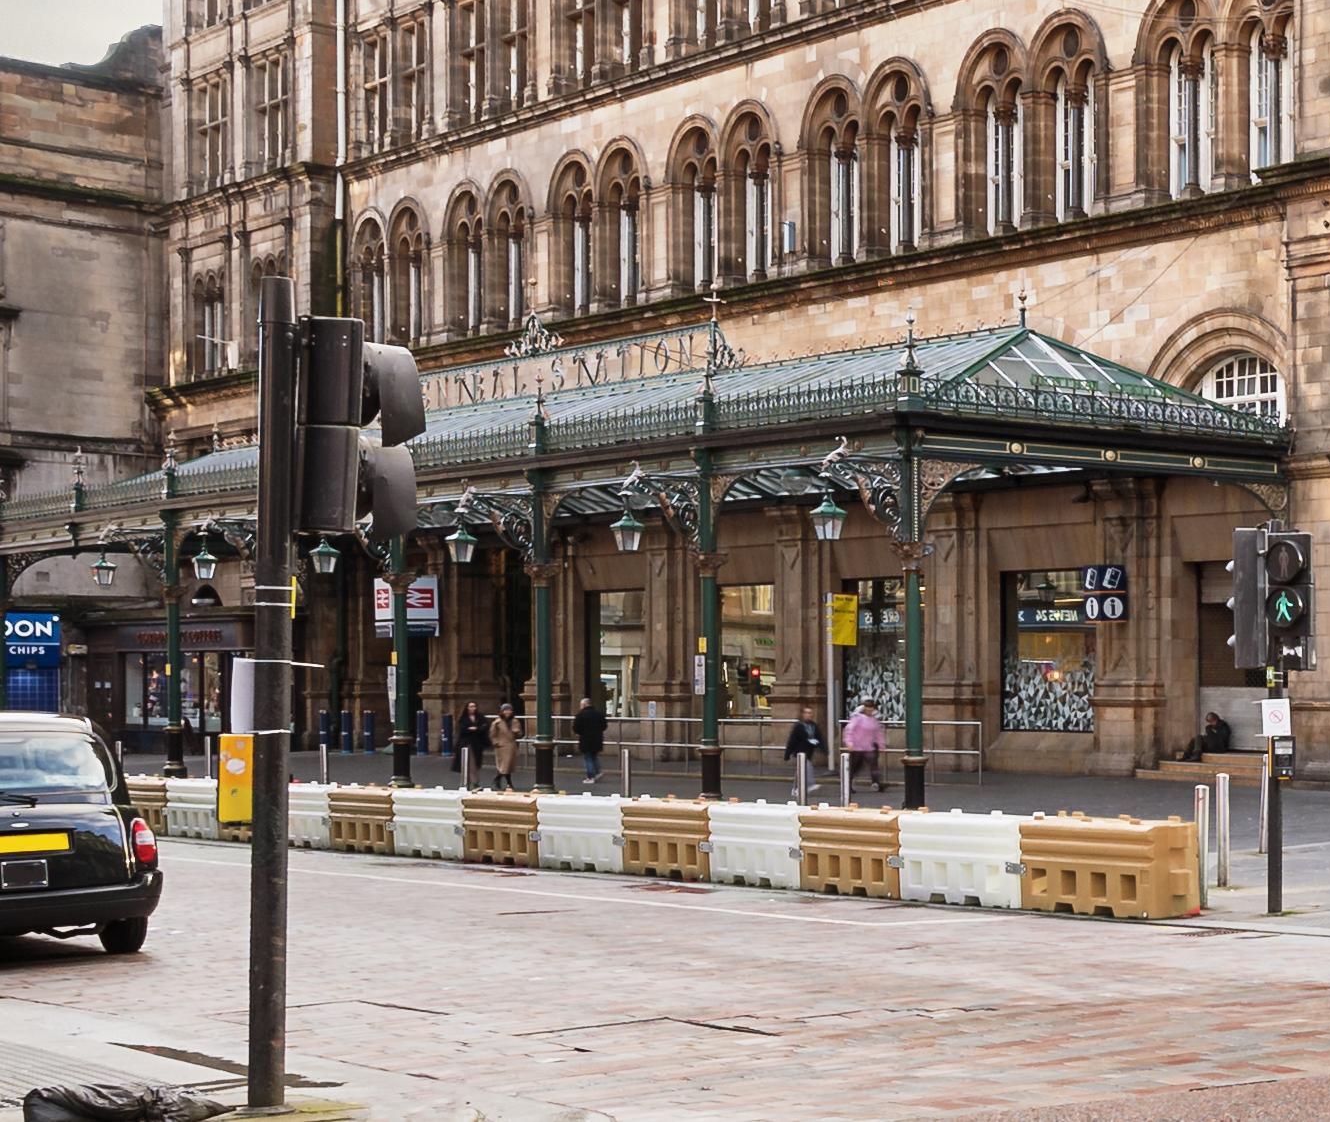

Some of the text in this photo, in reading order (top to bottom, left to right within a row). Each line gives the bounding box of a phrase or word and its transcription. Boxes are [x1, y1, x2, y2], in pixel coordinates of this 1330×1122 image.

[420, 334, 694, 411] ENTRAL STATION
[9, 646, 46, 655] CHIPS
